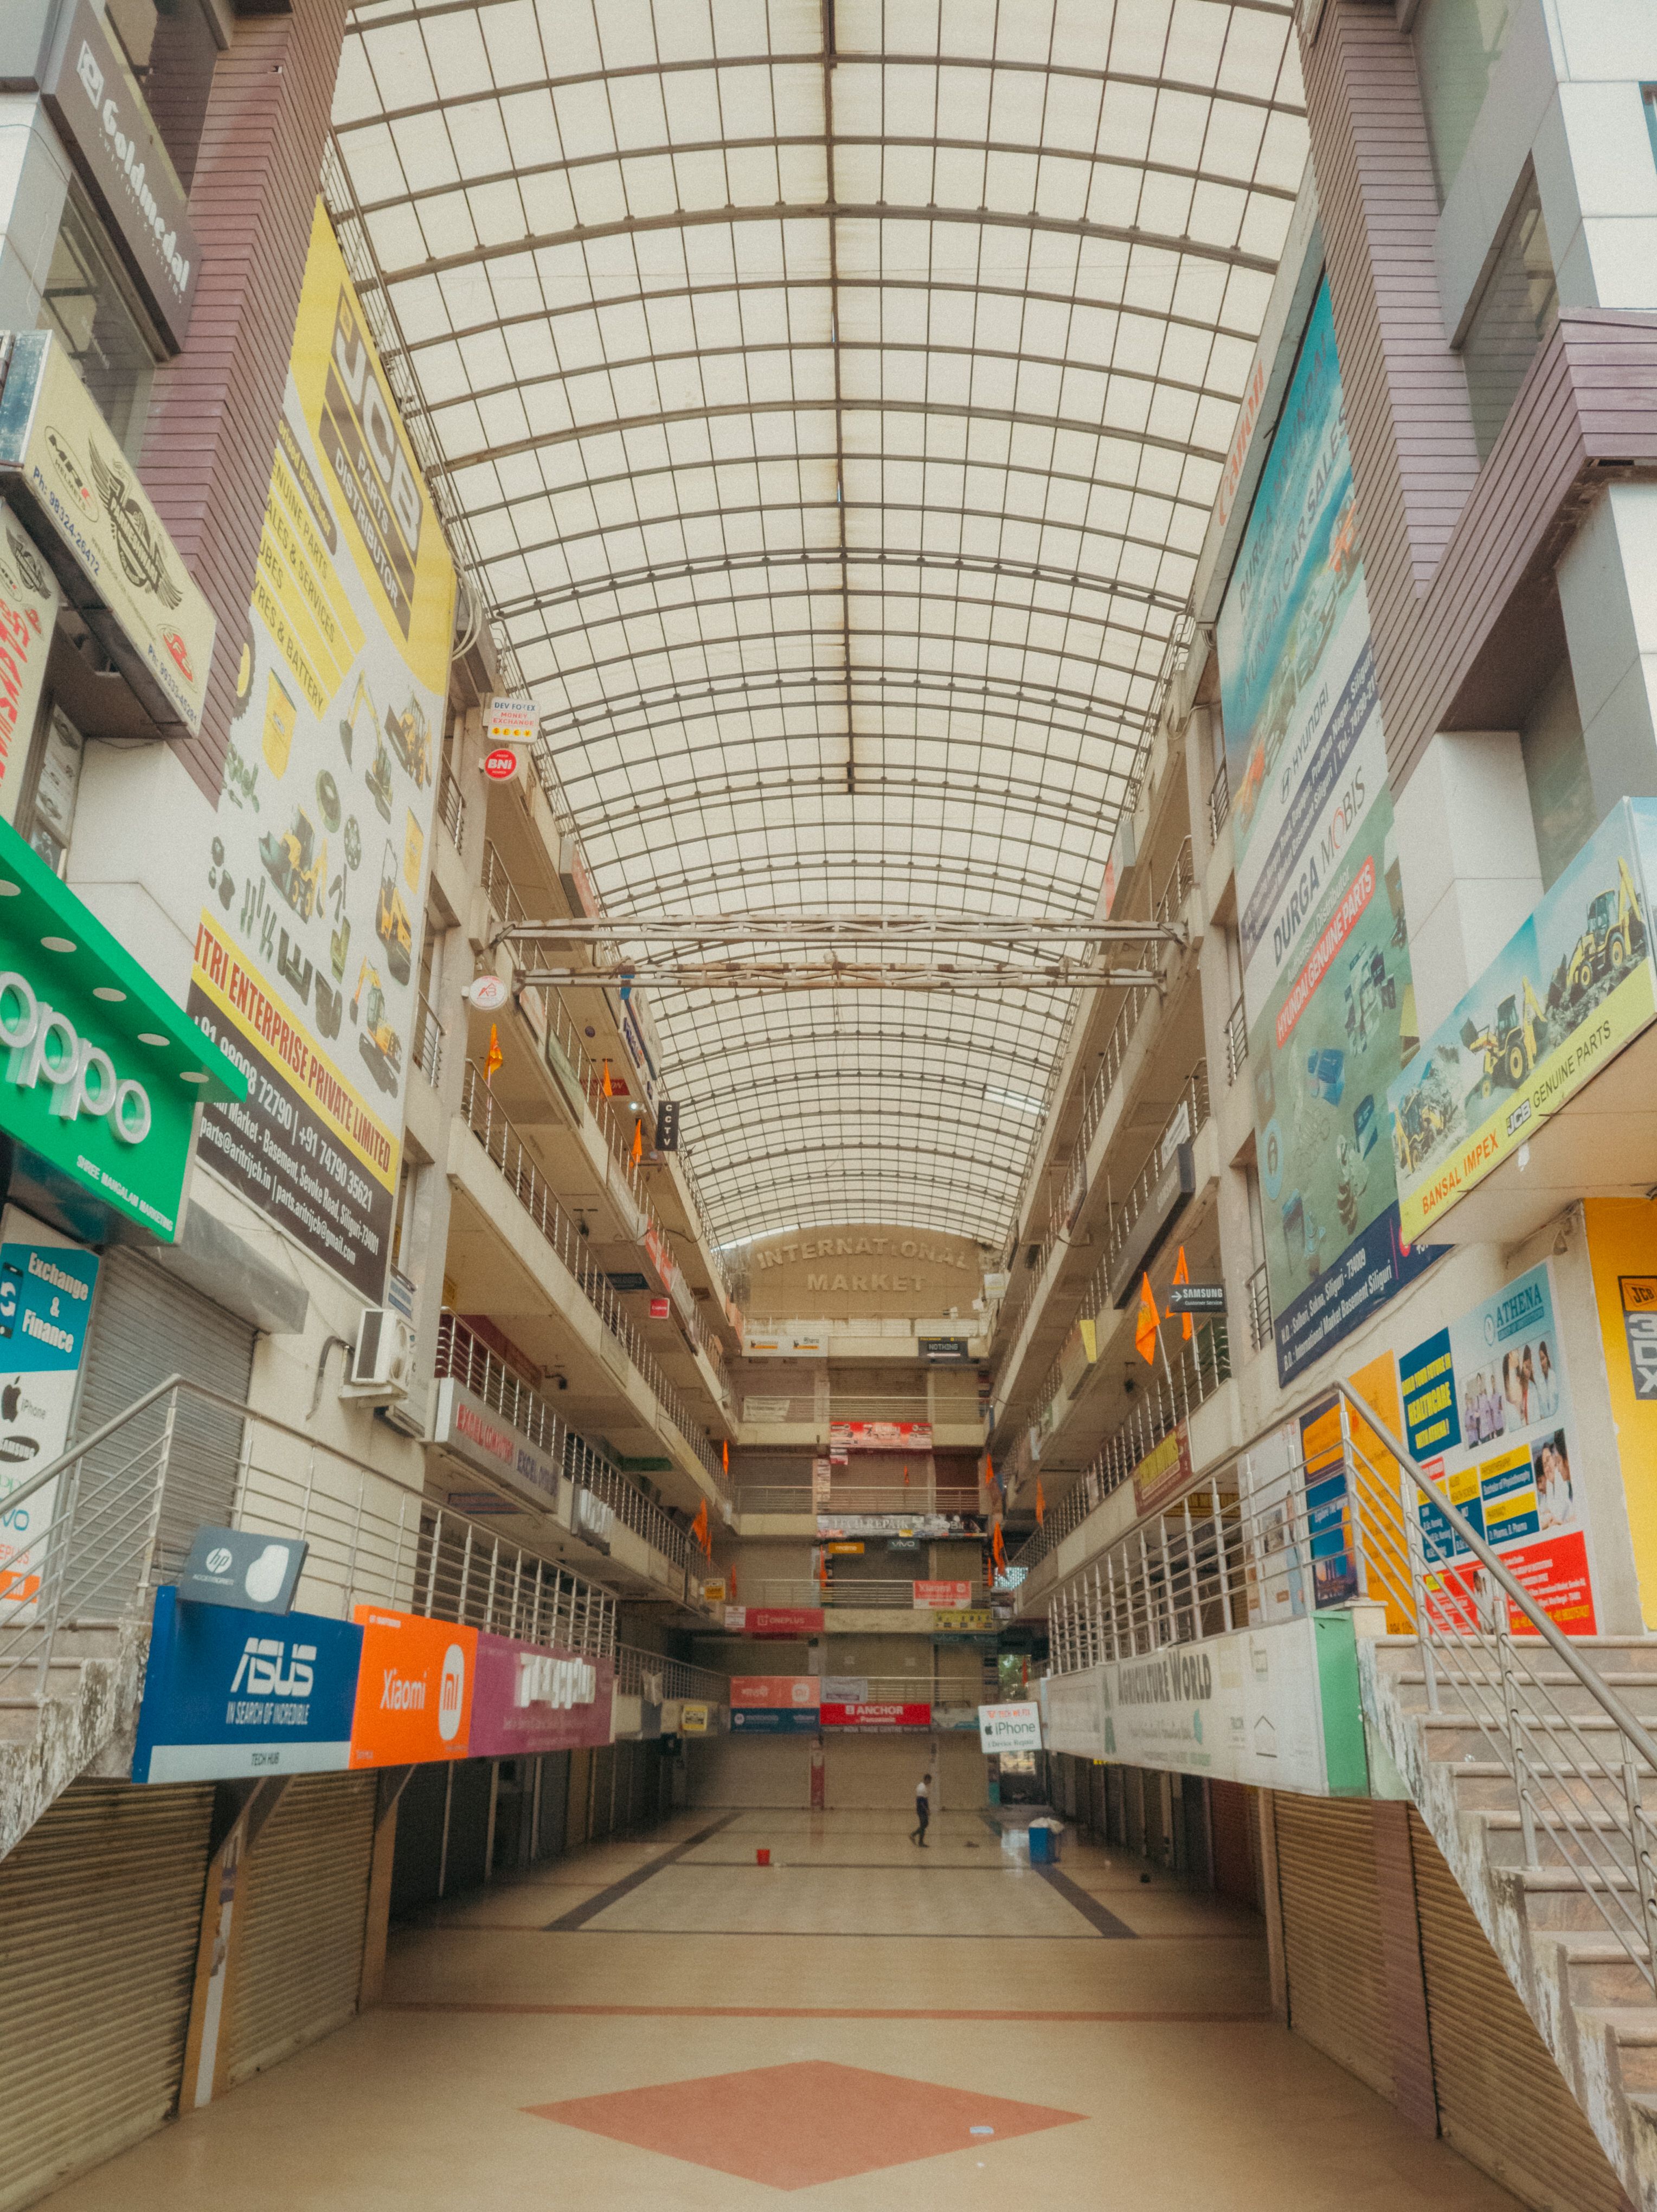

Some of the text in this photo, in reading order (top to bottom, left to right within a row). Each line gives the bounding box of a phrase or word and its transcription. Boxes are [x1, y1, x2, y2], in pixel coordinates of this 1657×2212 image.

[102, 99, 190, 292] Goldmedal
[336, 329, 421, 552] JCB
[1218, 359, 1265, 526] Canon
[358, 449, 389, 535] PARTS
[273, 459, 329, 581] ENUINE PARTS
[334, 447, 399, 607] DISTRIBUTOR
[261, 542, 284, 589] UBES
[267, 508, 290, 550] ALES
[298, 557, 336, 644] SERVICES
[1281, 528, 1309, 590] CAR
[286, 635, 325, 712] BATTERY
[1293, 683, 1328, 775] HYUNDAI
[1314, 761, 1333, 811] Siliguri
[1270, 763, 1366, 967] DURGA MOBIS
[1275, 861, 1372, 1041] HYUNDAI GENUINE PARTS
[0, 971, 151, 1144] oppo
[194, 922, 392, 1174] ITRI ENTERPRISE PRIVATE LIMITED
[664, 1104, 672, 1146] CCTV
[1420, 1017, 1610, 1216] BANSAL IMPEX JCB GENUINE PARTS
[229, 1105, 259, 1142] Market
[262, 1132, 299, 1182] Basement,
[299, 1162, 323, 1202] Sevoke
[324, 1187, 339, 1221] Road,
[259, 1077, 293, 1130] 72790
[299, 1121, 318, 1159] +91
[320, 1139, 348, 1188] 74790
[347, 1167, 373, 1212] 35621
[139, 1200, 173, 1232] MARKETING
[199, 1115, 356, 1266] parts@aritrijcb.in parts.aritrijcb@gmail.com
[28, 1251, 89, 1301] Exchange
[756, 1237, 971, 1272] INTERNATIONAL
[49, 1296, 60, 1317] &
[807, 1274, 926, 1292] MARKET
[1183, 1288, 1223, 1298] SAMSUNG
[1295, 1320, 1323, 1361] International
[1323, 1303, 1341, 1335] Market
[1341, 1279, 1368, 1319] Basement
[1368, 1256, 1391, 1296] Siliguri
[1325, 1269, 1344, 1303] Siliguri
[1497, 1283, 1543, 1328] ATHENA
[1631, 1287, 1655, 1304] JCB
[22, 1308, 74, 1353] Finance
[21, 1398, 46, 1419] iPhone
[1406, 1380, 1452, 1427] HEALTHCARE
[209, 1548, 231, 1573] hp
[230, 1637, 318, 1697] ASUS
[380, 1668, 460, 1711] Xiaomi mi
[1119, 1649, 1212, 1706] AGRICULTURE WORLD
[226, 1701, 310, 1726] IN SEARCH OF INCREDIBLE
[857, 1706, 904, 1715] ANCHOR
[995, 1721, 1036, 1735] iPhone
[251, 1752, 280, 1766] TECH HUB
